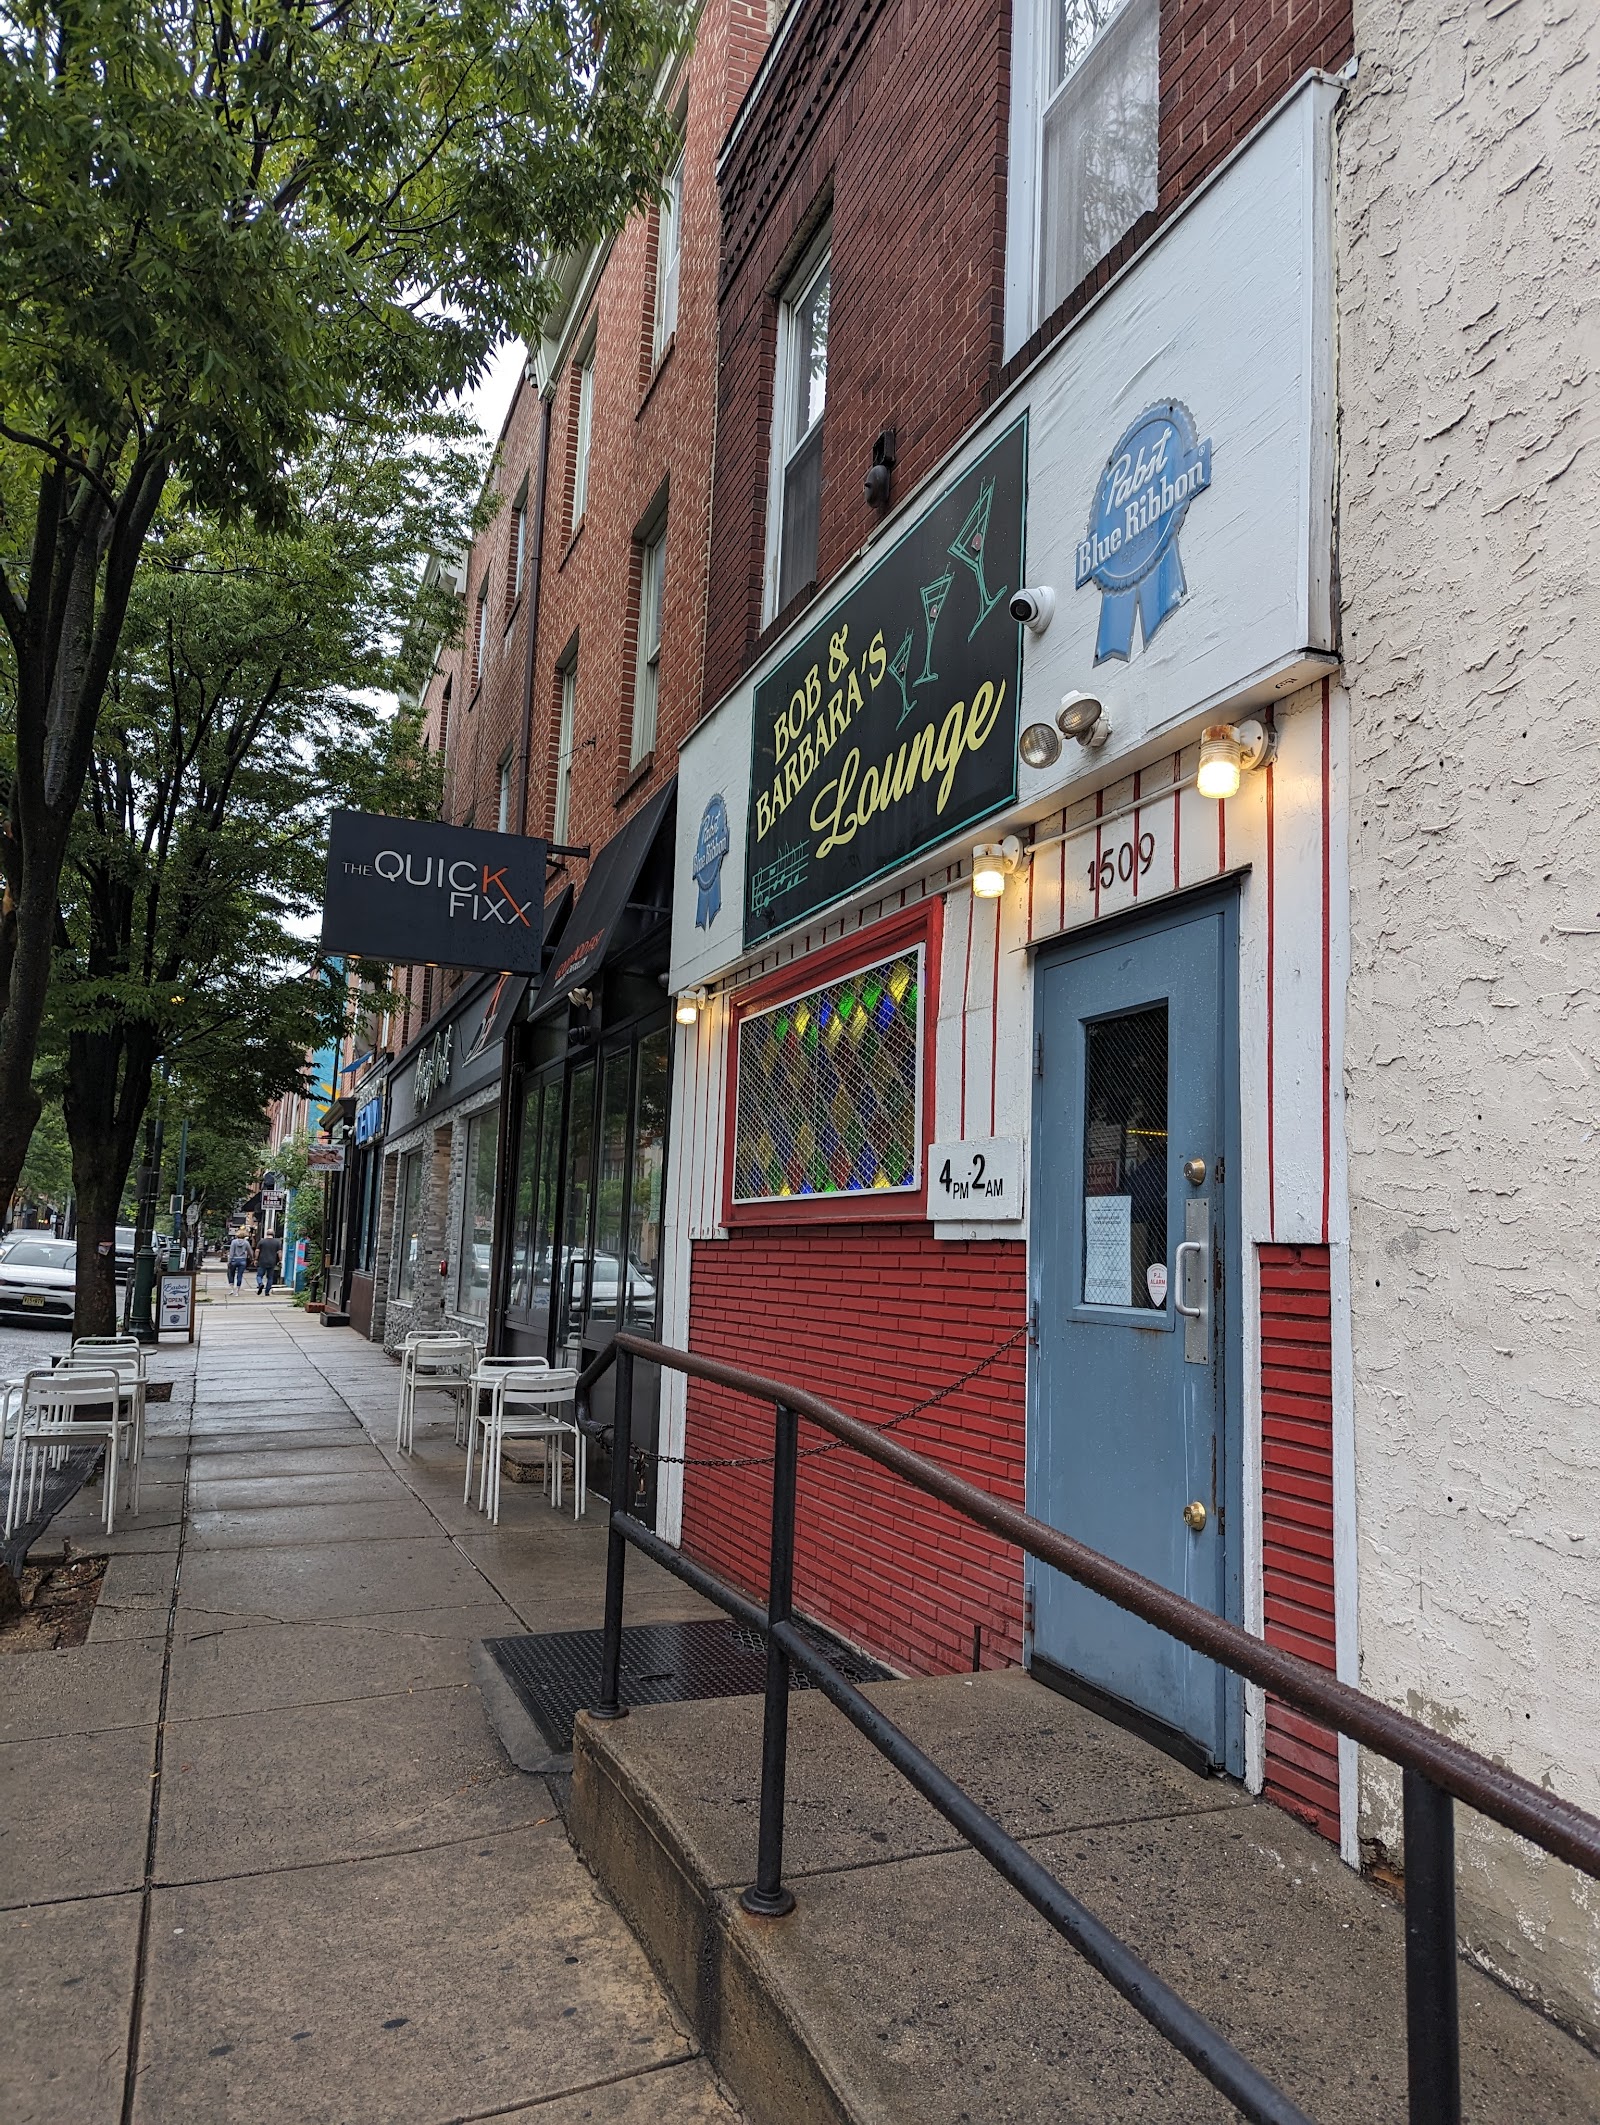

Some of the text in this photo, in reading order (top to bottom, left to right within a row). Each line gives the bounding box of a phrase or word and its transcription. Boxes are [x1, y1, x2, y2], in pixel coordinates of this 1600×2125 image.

[1077, 527, 1121, 581] Blue
[1124, 461, 1205, 544] Ribbon
[1104, 427, 1172, 516] Pabst
[755, 628, 887, 843] BARBARA'S
[773, 624, 849, 766] BOB &
[809, 678, 1006, 859] Lounge
[342, 850, 514, 901] THE QUICK
[1087, 832, 1155, 892] 1509
